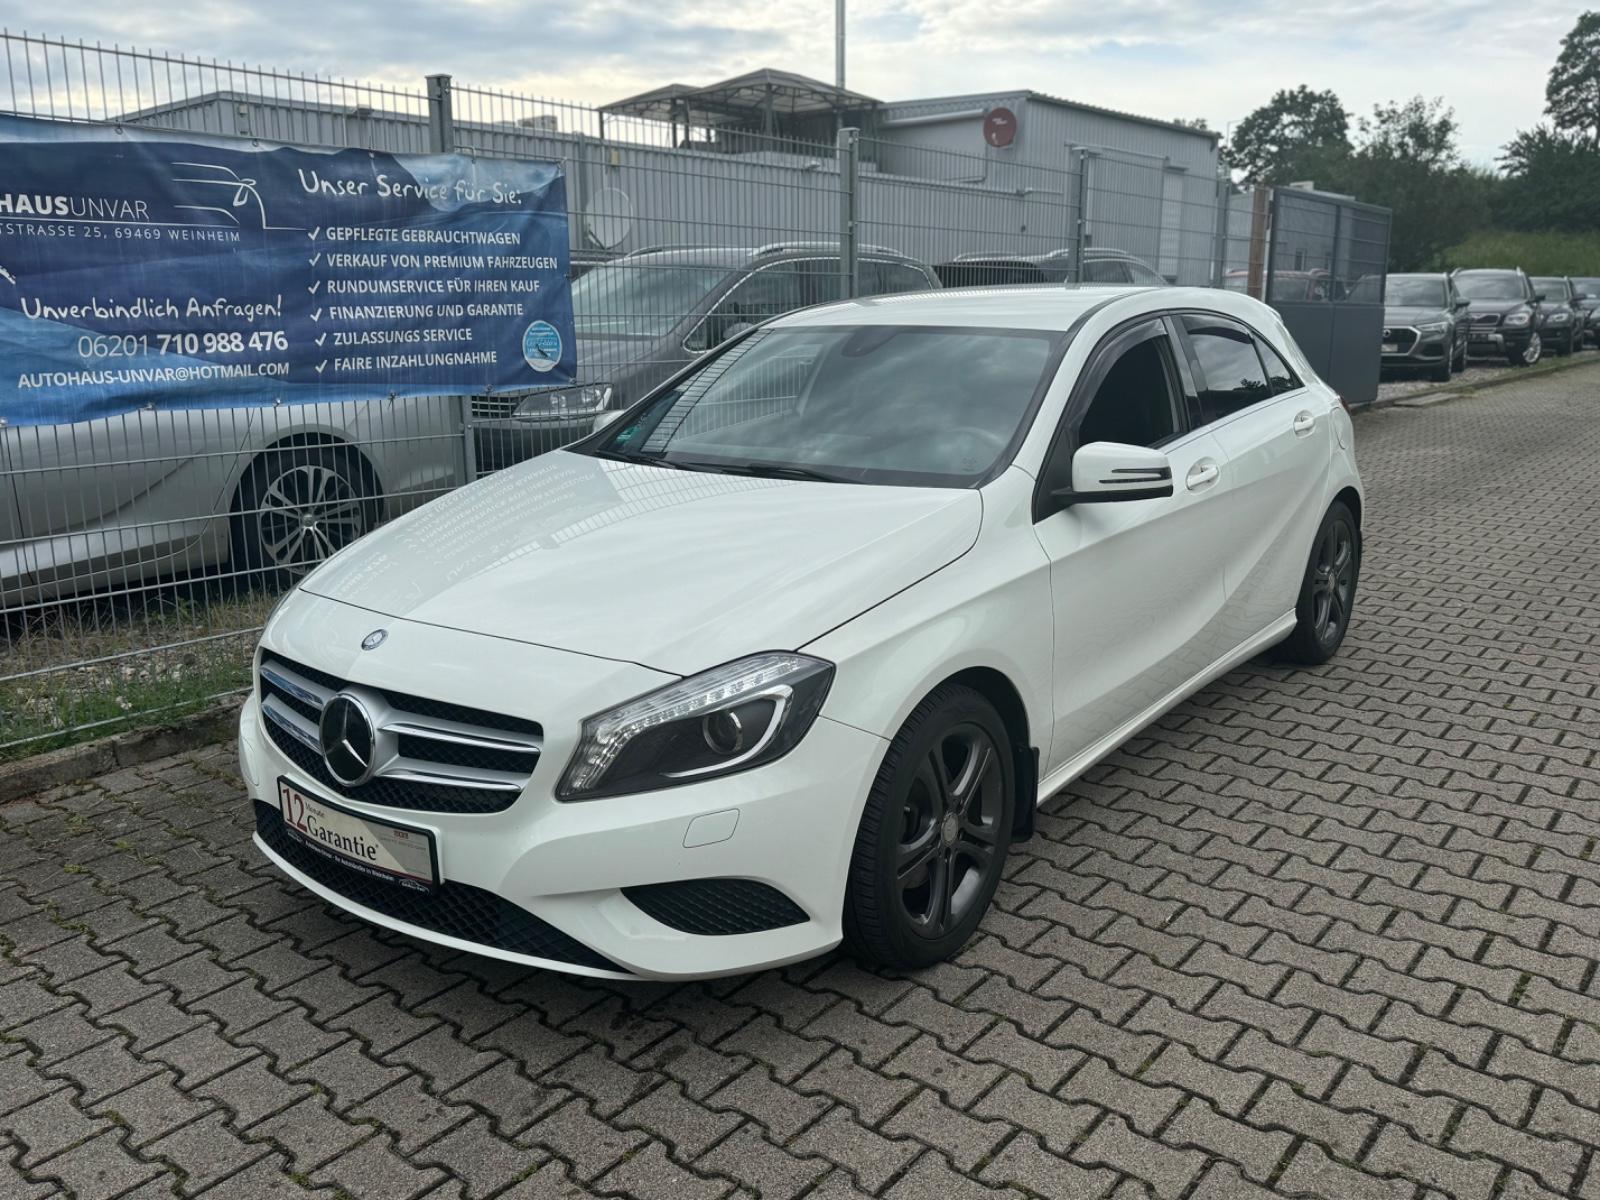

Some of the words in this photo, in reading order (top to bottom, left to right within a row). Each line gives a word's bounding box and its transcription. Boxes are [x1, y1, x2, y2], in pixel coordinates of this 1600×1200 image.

[298, 168, 369, 195] Unser
[376, 174, 448, 201] Service
[453, 180, 486, 202] für
[492, 182, 522, 205] Sie:
[83, 226, 107, 240] 25,
[115, 227, 161, 240] 69469
[168, 229, 240, 242] WEINHEIM
[326, 227, 399, 242] GEPFLEGTE
[401, 230, 521, 245] GEBRAUCHTWAGEN
[327, 254, 388, 268] VERKAUF
[390, 255, 420, 268] VON
[424, 256, 484, 269] PREMIUM
[487, 256, 558, 270] FAHRZEUGEN
[327, 279, 445, 294] RUNDUMSERVICE
[447, 277, 472, 293] FÜR
[474, 280, 508, 293] IHREN
[510, 280, 540, 293] KAUF
[21, 297, 179, 320] Unverbindlich
[186, 294, 282, 322] Anfragen!
[329, 304, 434, 320] FINANZIERUNG
[436, 304, 464, 317] UND
[467, 303, 524, 317] GARANTIE
[78, 334, 149, 358] 06201
[156, 333, 199, 356] 710
[203, 332, 244, 353] 988
[248, 330, 289, 352] 476
[333, 330, 420, 346] ZULASSUNGS
[423, 327, 473, 342] SERVICE
[334, 355, 373, 371] FAIRE
[376, 351, 497, 370] INZAHLUNGNAHME
[18, 362, 290, 389] AUTOHAUS-UNVAR@HOTMAIL.COM
[283, 788, 308, 833] 12
